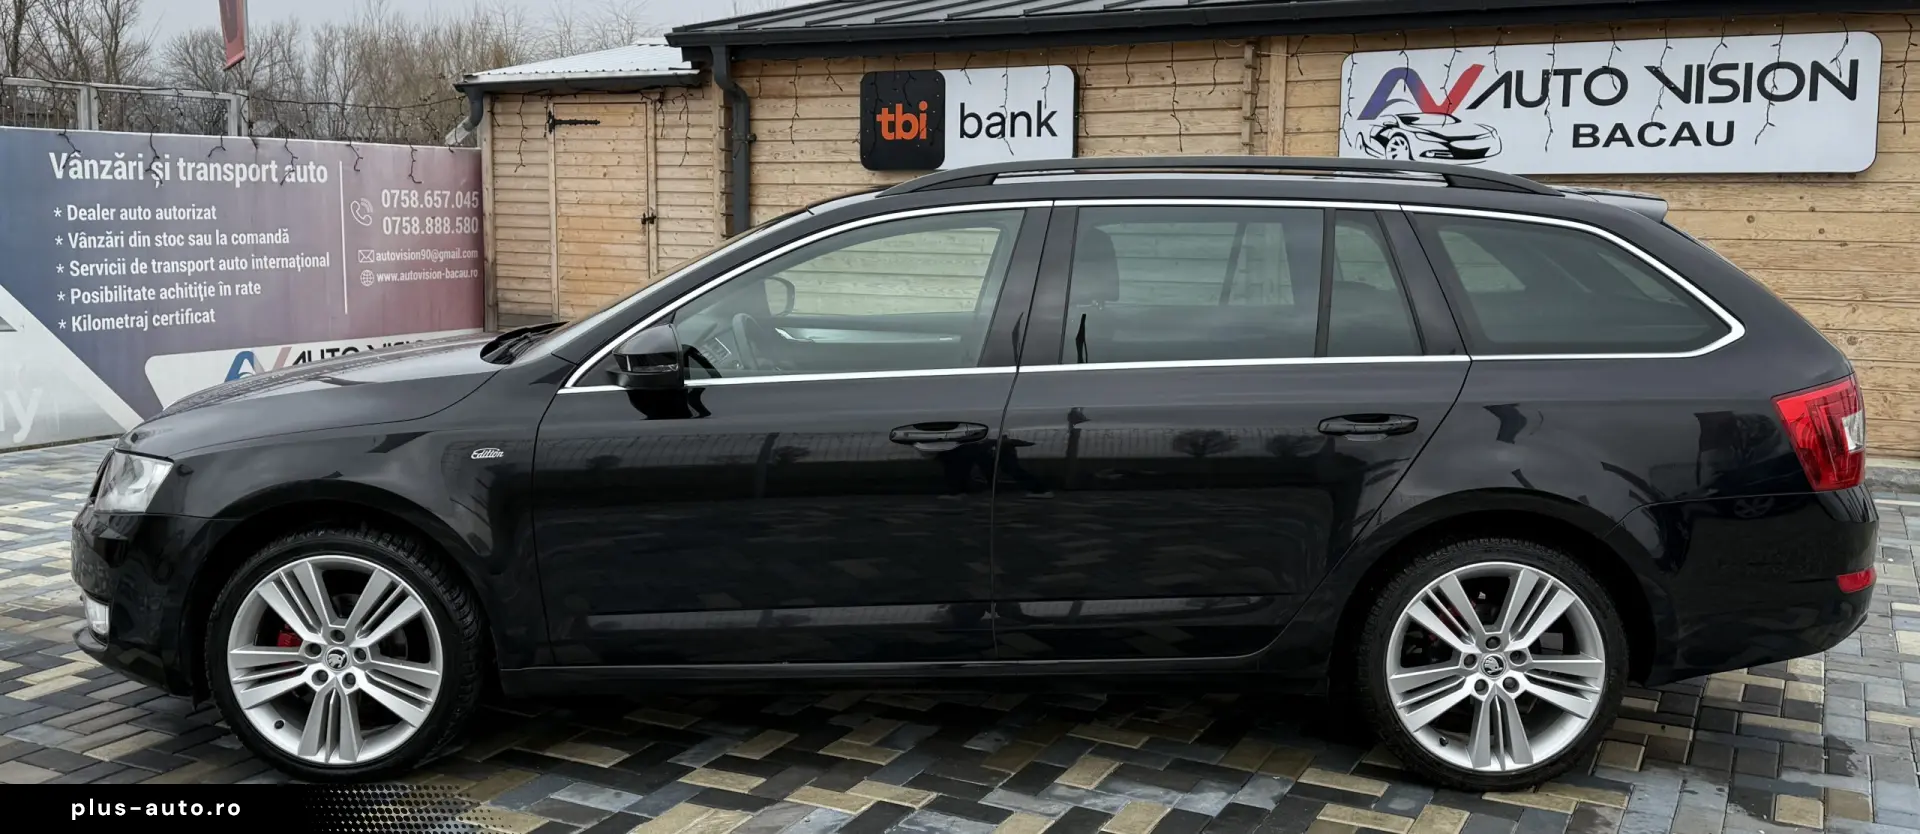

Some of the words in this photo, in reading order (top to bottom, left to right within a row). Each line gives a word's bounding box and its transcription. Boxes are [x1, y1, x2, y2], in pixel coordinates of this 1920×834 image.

[1466, 67, 1629, 109] AUTO
[1644, 59, 1860, 105] VISION
[876, 100, 928, 141] tbi
[959, 100, 1058, 139] bank
[1571, 120, 1736, 148] BACAU
[49, 152, 144, 181] Vânzări
[177, 157, 278, 188] transport
[284, 164, 328, 183] auto
[381, 189, 479, 209] 0758.657.045
[67, 204, 116, 221] Dealer
[119, 206, 152, 220] auto
[155, 204, 217, 220] autorizat
[382, 216, 479, 235] 0758.888.580
[68, 231, 124, 249] Vânzări
[128, 230, 151, 247] din
[154, 232, 185, 246] stoc
[188, 232, 212, 246] sau
[215, 229, 228, 245] la
[231, 228, 289, 245] comandă
[375, 247, 478, 262] autovision90@gmail.com
[69, 258, 127, 277] Servicii
[130, 256, 148, 274] de
[151, 256, 215, 276] transport
[218, 256, 248, 271] auto
[376, 268, 478, 282] www.autovision-bacau.ro
[70, 285, 156, 304] Posibilitate
[218, 281, 232, 297] în
[235, 281, 262, 295] rate
[71, 310, 149, 332] Kilometraj
[152, 308, 216, 326] certificat
